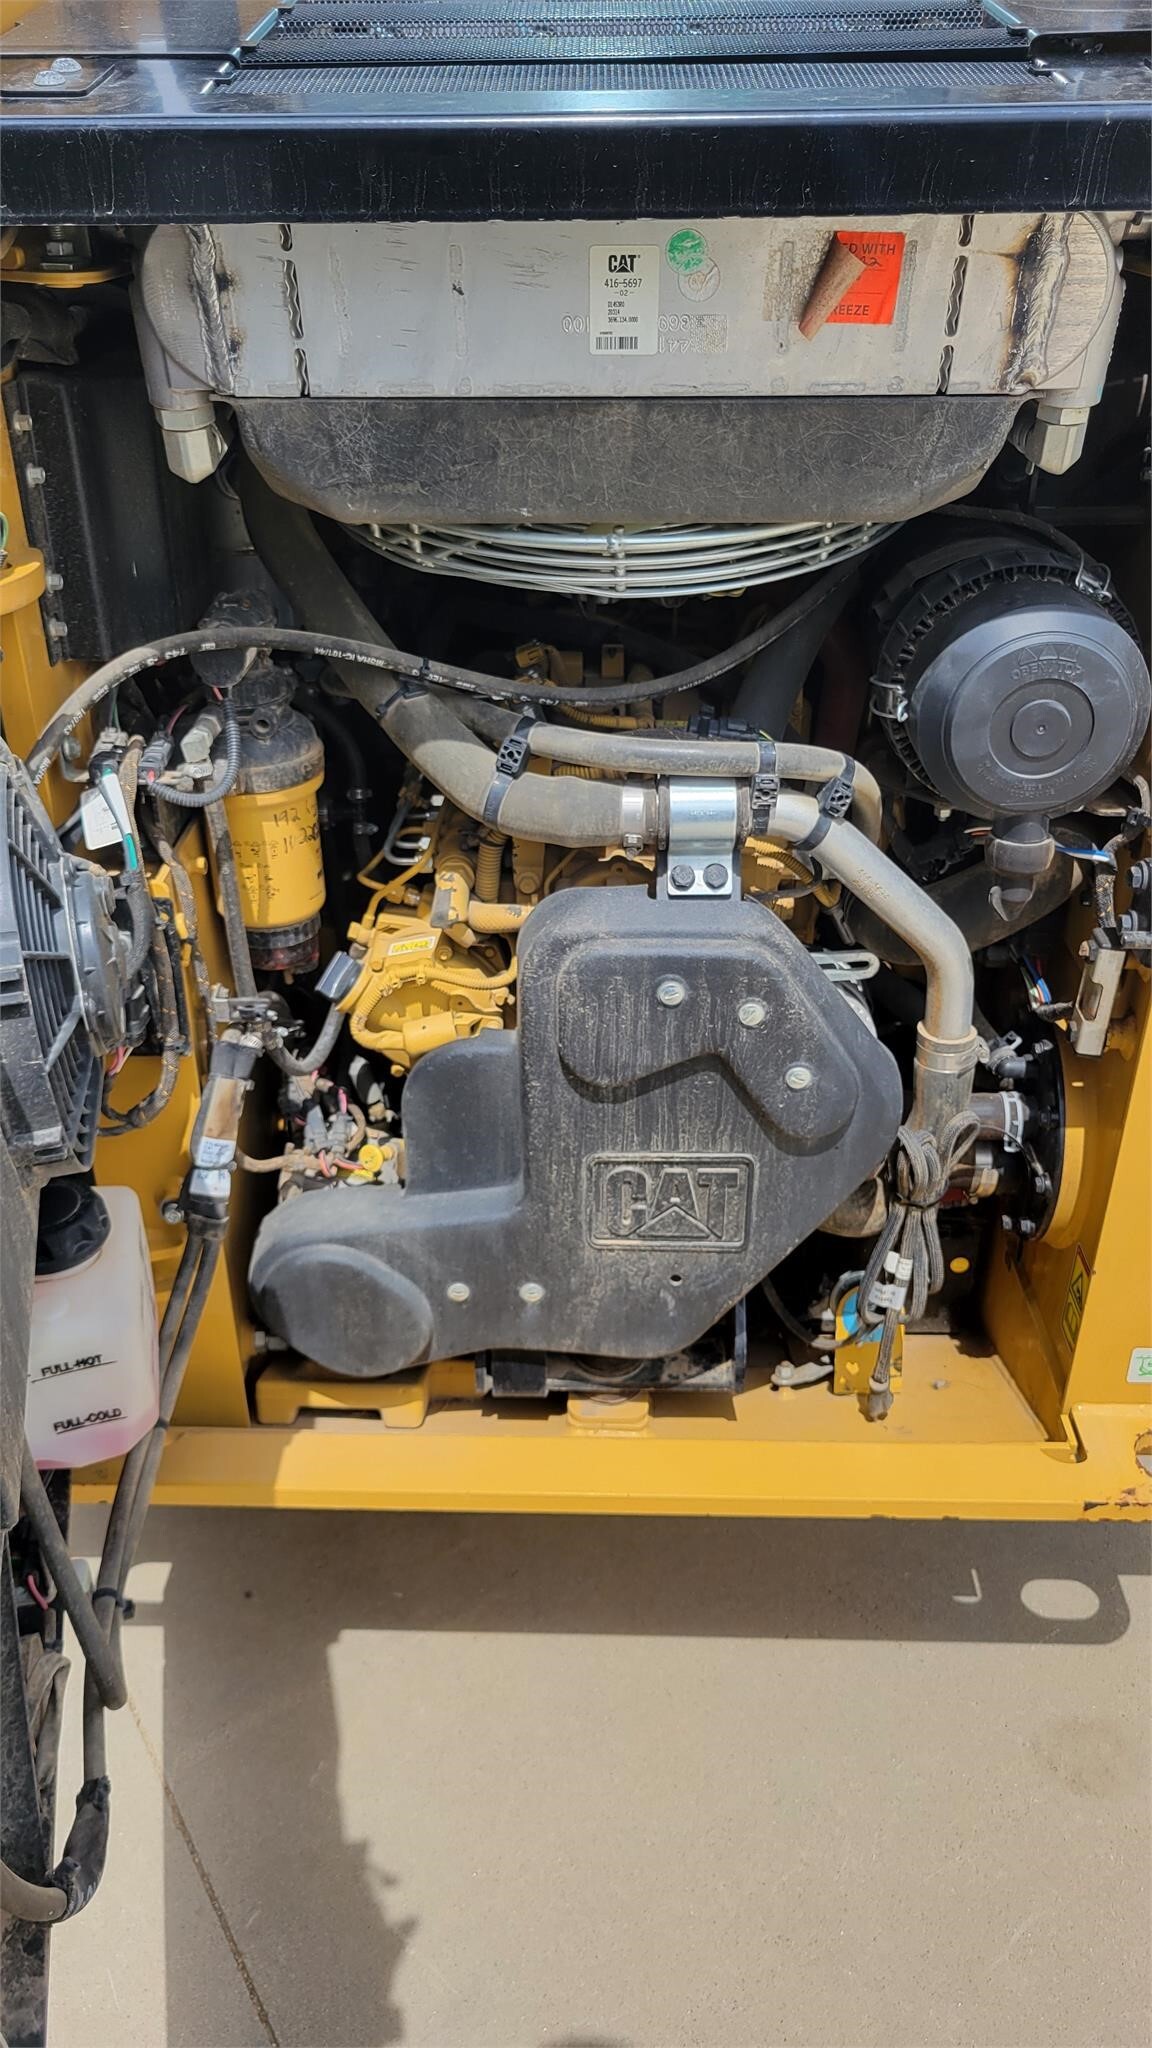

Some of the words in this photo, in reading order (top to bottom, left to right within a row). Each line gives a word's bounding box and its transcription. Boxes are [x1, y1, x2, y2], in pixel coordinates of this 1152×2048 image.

[862, 244, 896, 255] WITH
[608, 254, 637, 273] CAT
[605, 279, 642, 288] 416-5697
[831, 304, 870, 315] REEZE
[606, 1166, 740, 1239] CAT
[41, 1353, 102, 1376] FULL-HOT
[53, 1408, 122, 1431] FULL-COLD
